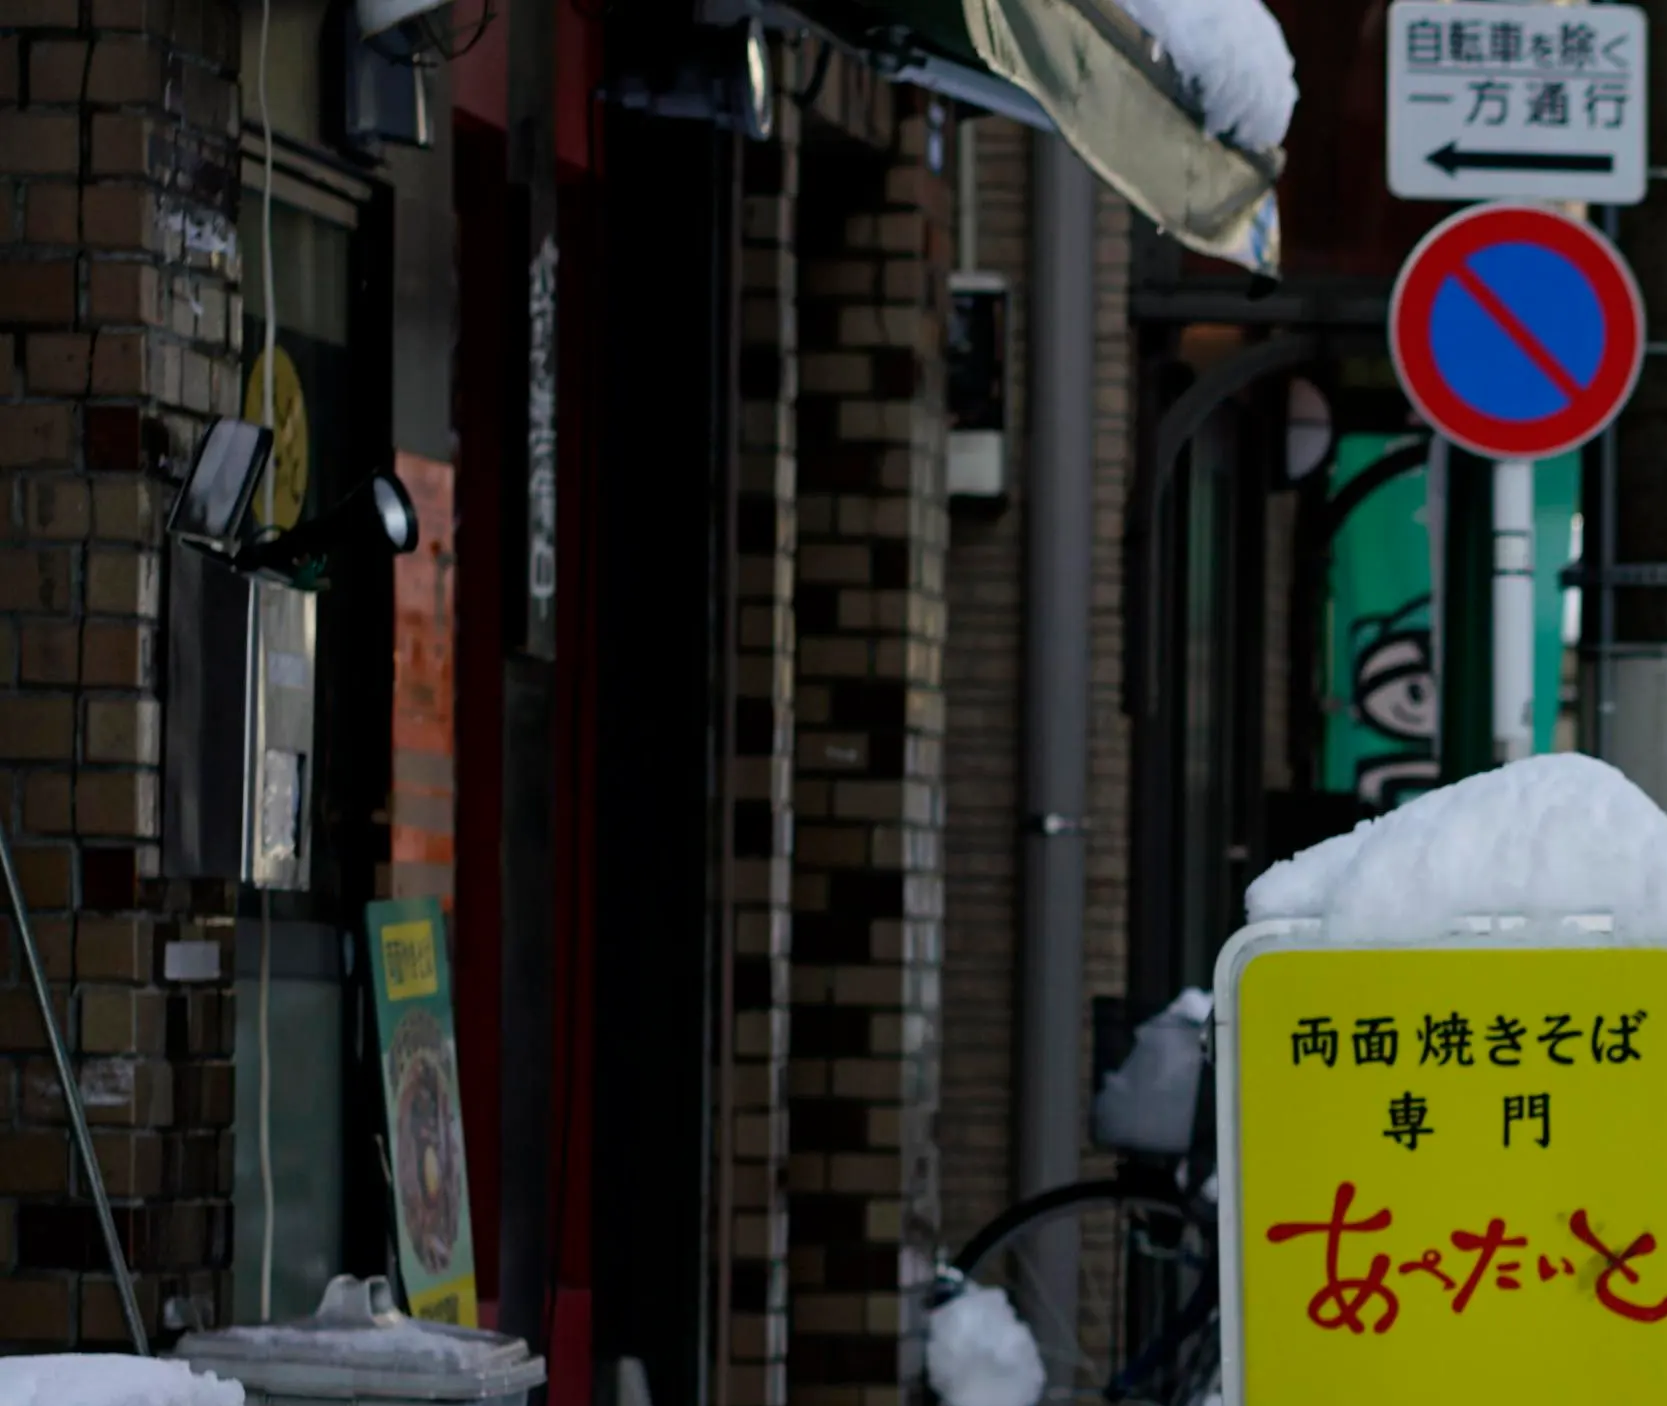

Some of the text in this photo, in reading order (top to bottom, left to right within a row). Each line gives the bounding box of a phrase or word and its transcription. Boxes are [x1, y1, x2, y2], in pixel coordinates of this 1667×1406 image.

[1407, 18, 1630, 69] 自転車を除く
[1407, 80, 1628, 128] 一方通行
[1290, 1010, 1649, 1068] 両面焼きそば
[1382, 1091, 1552, 1151] 専門
